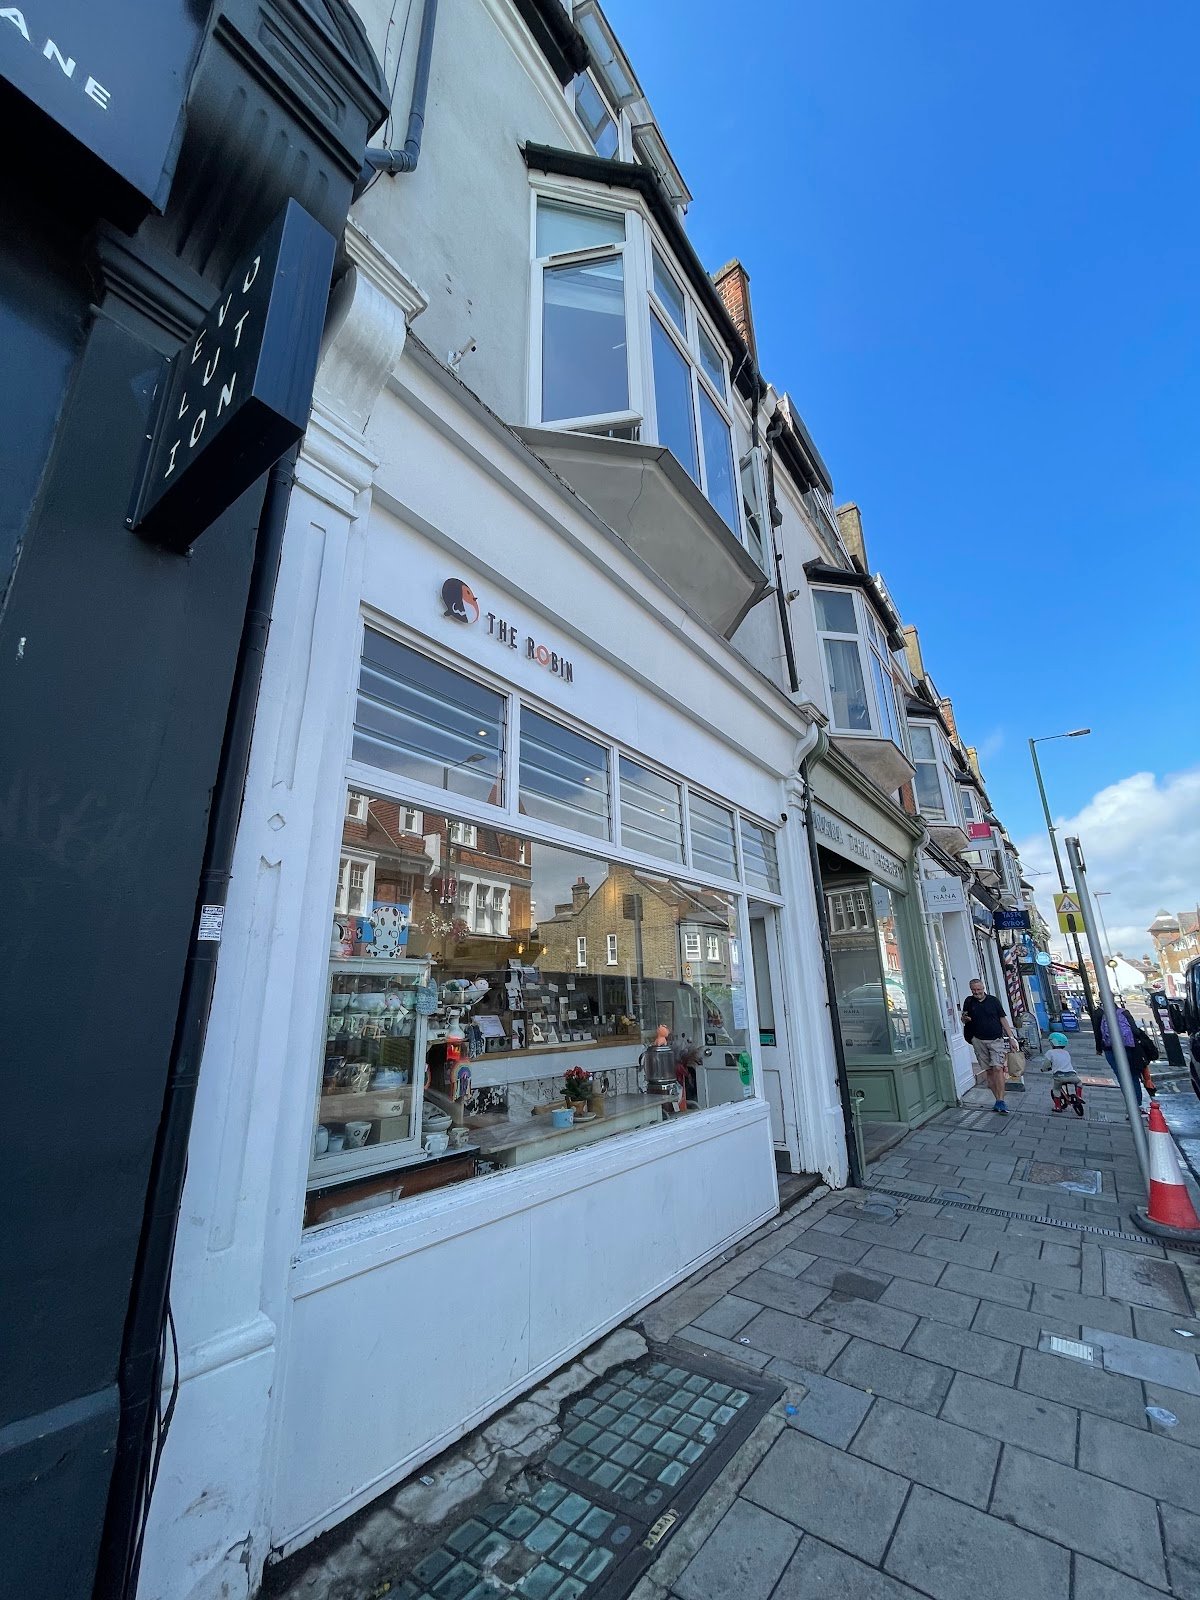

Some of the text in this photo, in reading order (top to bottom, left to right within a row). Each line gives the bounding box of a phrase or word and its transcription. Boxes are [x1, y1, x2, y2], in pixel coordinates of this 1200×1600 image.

[192, 255, 261, 364] EVO
[178, 310, 250, 420] LUT
[164, 372, 237, 478] ION
[486, 612, 574, 683] THE ROBIN
